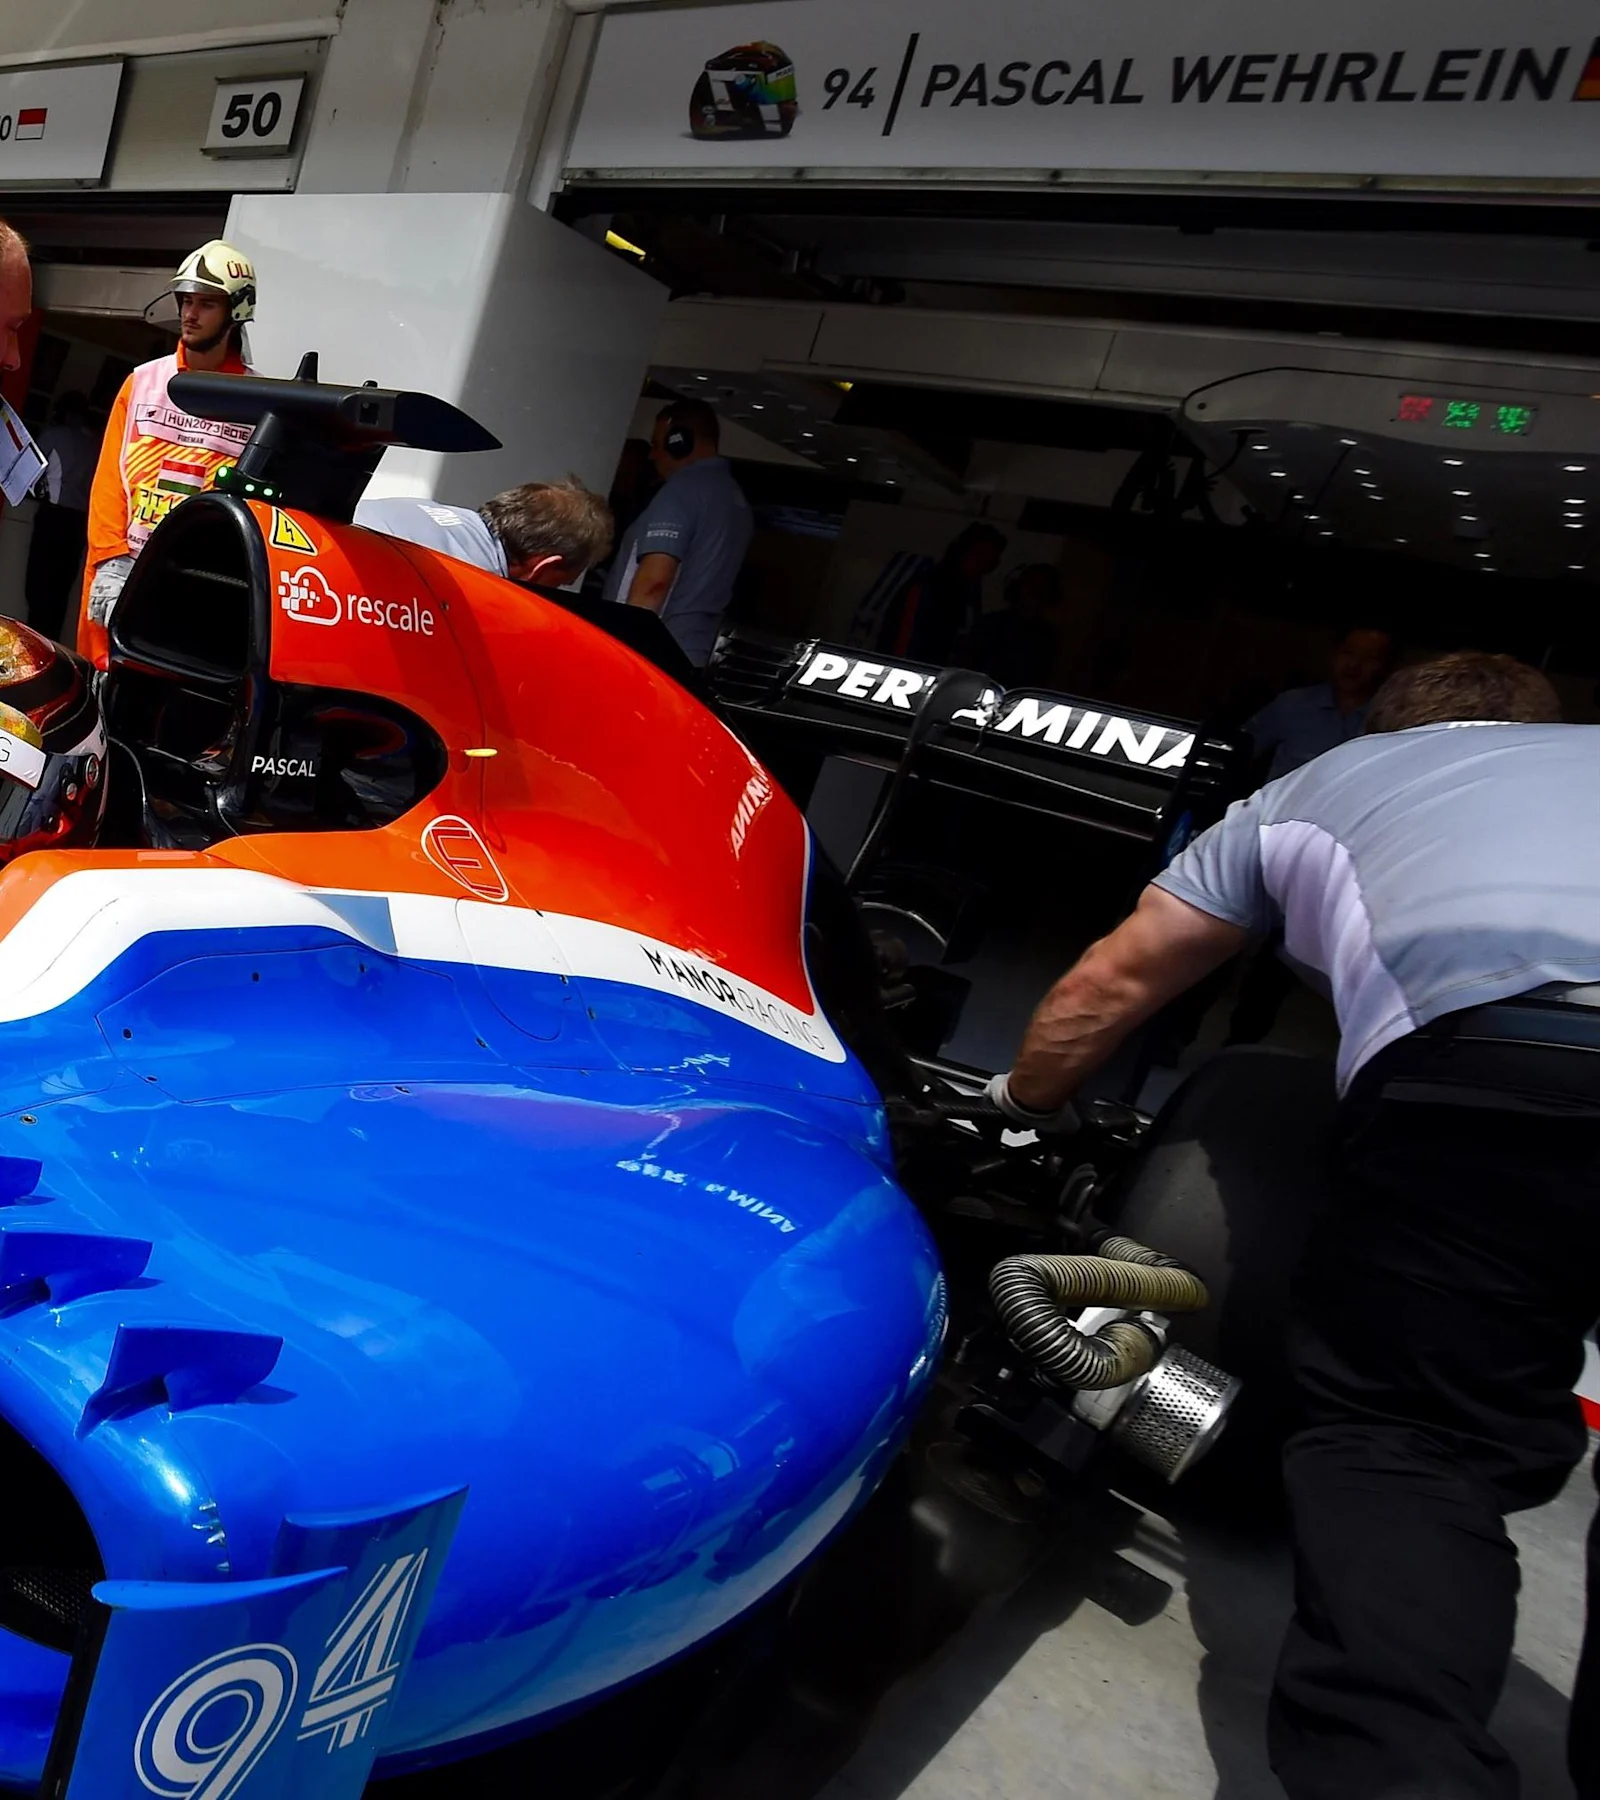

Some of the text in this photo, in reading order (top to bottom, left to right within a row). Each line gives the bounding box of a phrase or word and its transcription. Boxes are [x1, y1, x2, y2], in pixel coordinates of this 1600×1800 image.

[820, 45, 1570, 110] 94 PASCAL WEHRLEIN
[220, 90, 282, 140] 50
[167, 412, 250, 441] HUN2073 2016
[347, 594, 434, 636] rescale
[251, 755, 317, 778] PASCAL
[639, 943, 826, 1051] MANOR RACING
[133, 1547, 429, 1800] 94
